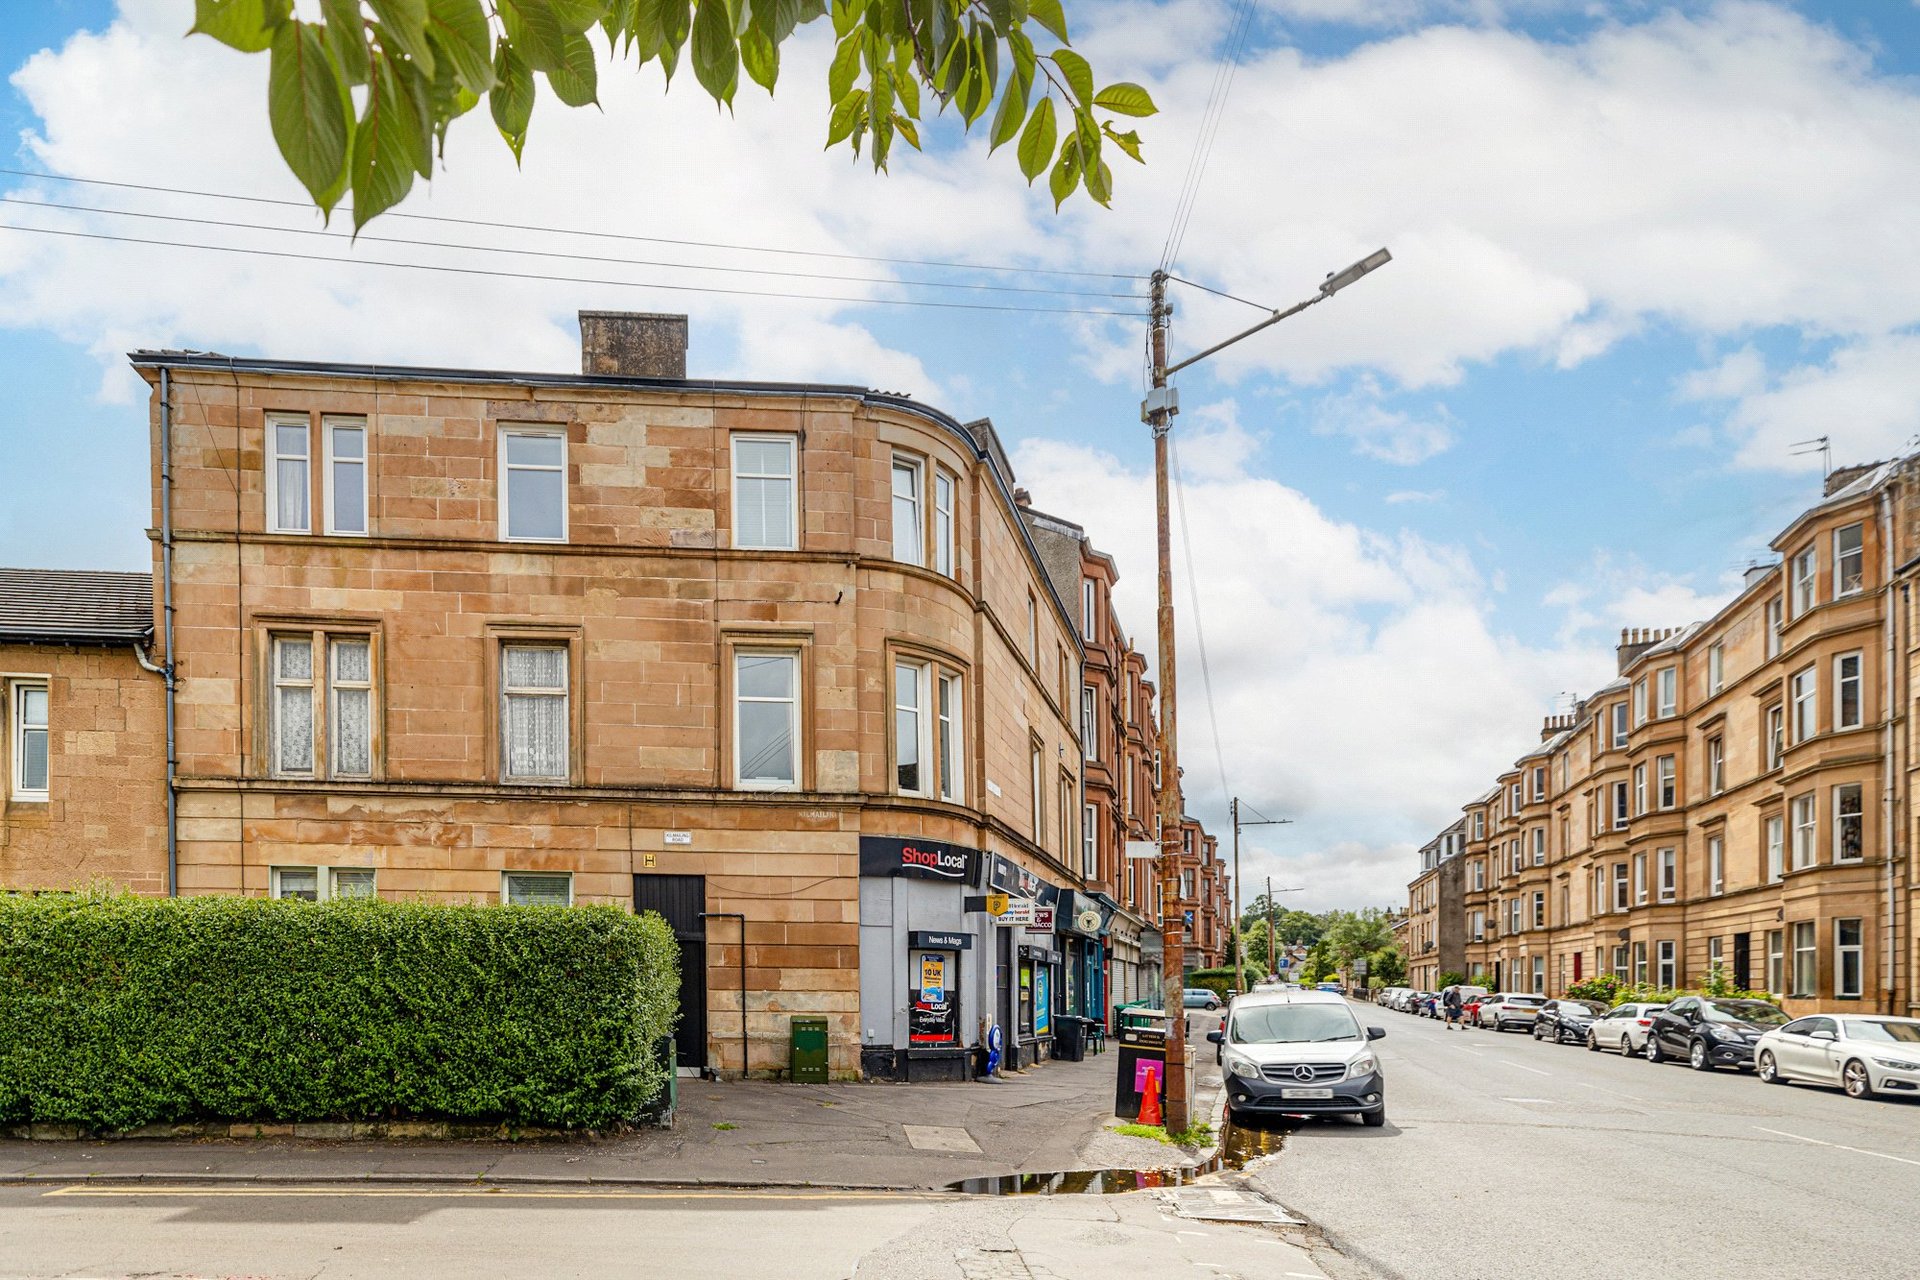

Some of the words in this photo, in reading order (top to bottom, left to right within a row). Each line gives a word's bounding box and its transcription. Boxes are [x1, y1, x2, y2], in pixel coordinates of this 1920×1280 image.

[902, 847, 965, 869] ShopLocal
[928, 935, 943, 944] News
[943, 936, 948, 945] &
[948, 936, 962, 947] Mags
